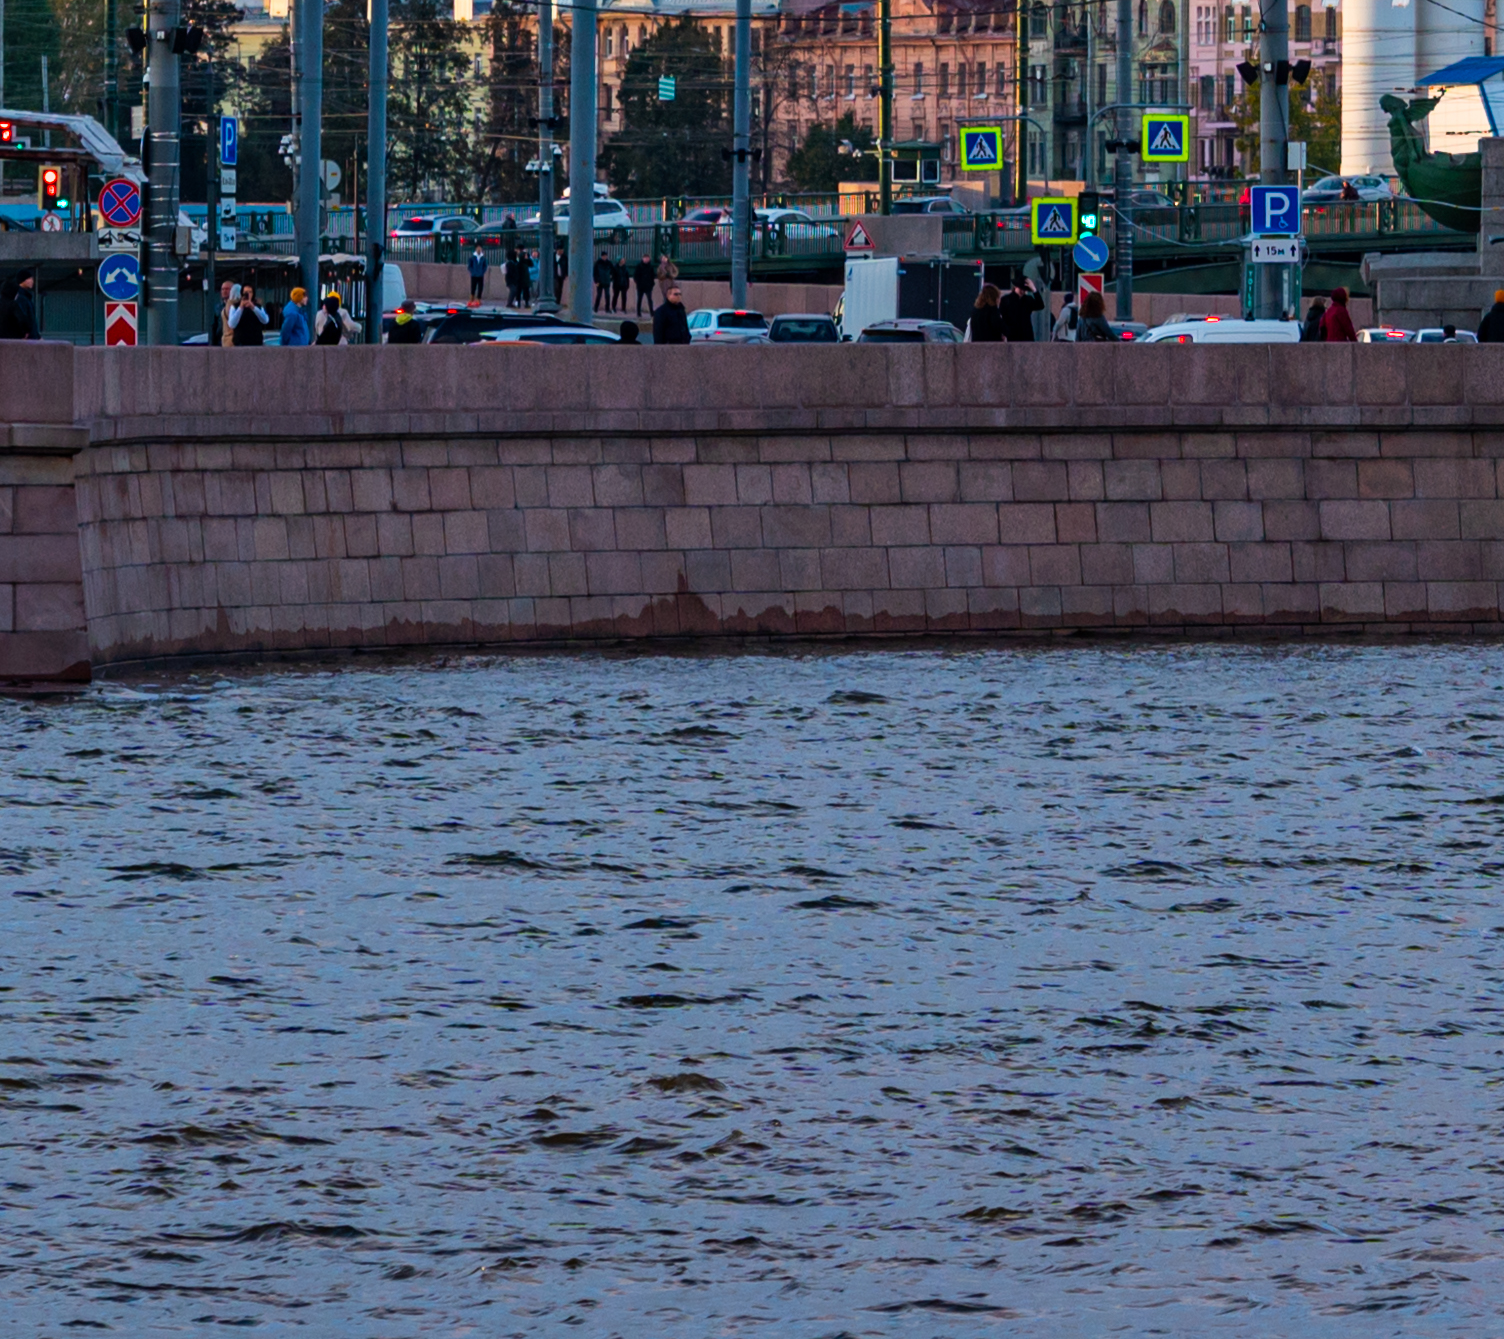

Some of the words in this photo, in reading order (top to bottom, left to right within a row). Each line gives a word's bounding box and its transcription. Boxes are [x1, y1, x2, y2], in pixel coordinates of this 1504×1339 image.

[225, 122, 234, 158] P
[1081, 214, 1096, 229] 40
[1265, 192, 1290, 229] P
[1266, 246, 1285, 256] 15м
